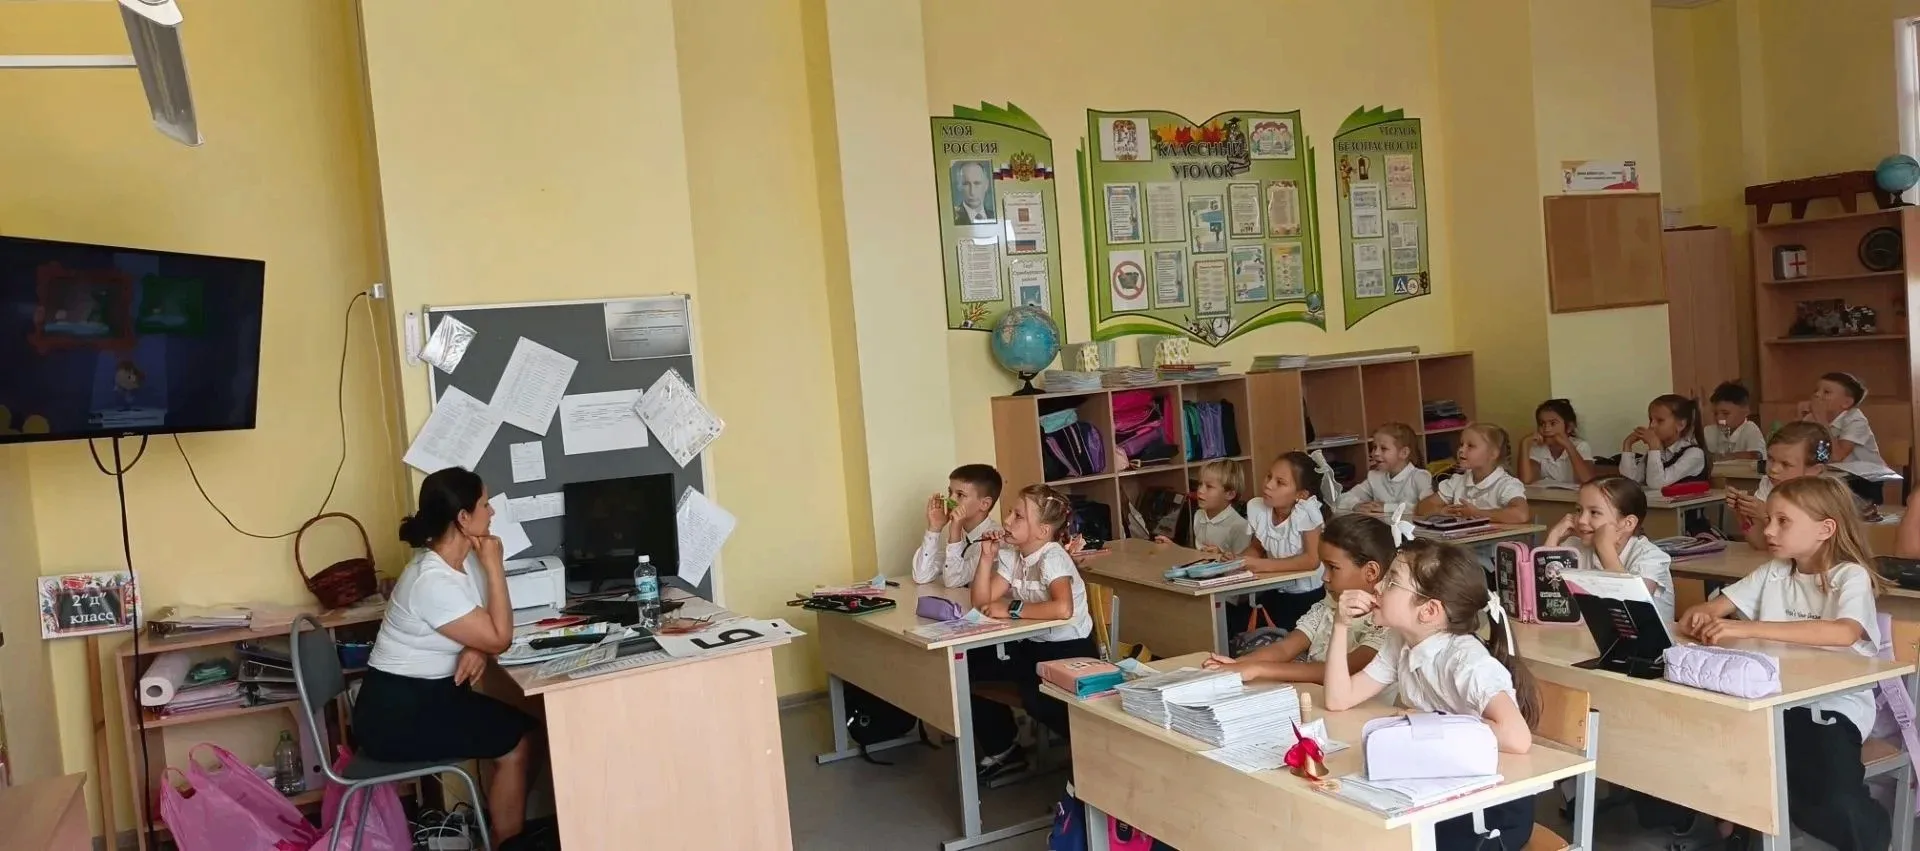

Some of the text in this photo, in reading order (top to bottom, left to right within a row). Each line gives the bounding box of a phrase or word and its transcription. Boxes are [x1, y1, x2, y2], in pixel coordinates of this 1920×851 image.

[941, 124, 972, 136] МОЯ
[943, 142, 998, 154] РОССИЯ
[1338, 141, 1418, 152] БЕЗОПАСНОСТИ
[1171, 163, 1234, 179] УГОЛОК
[70, 611, 114, 625] класс
